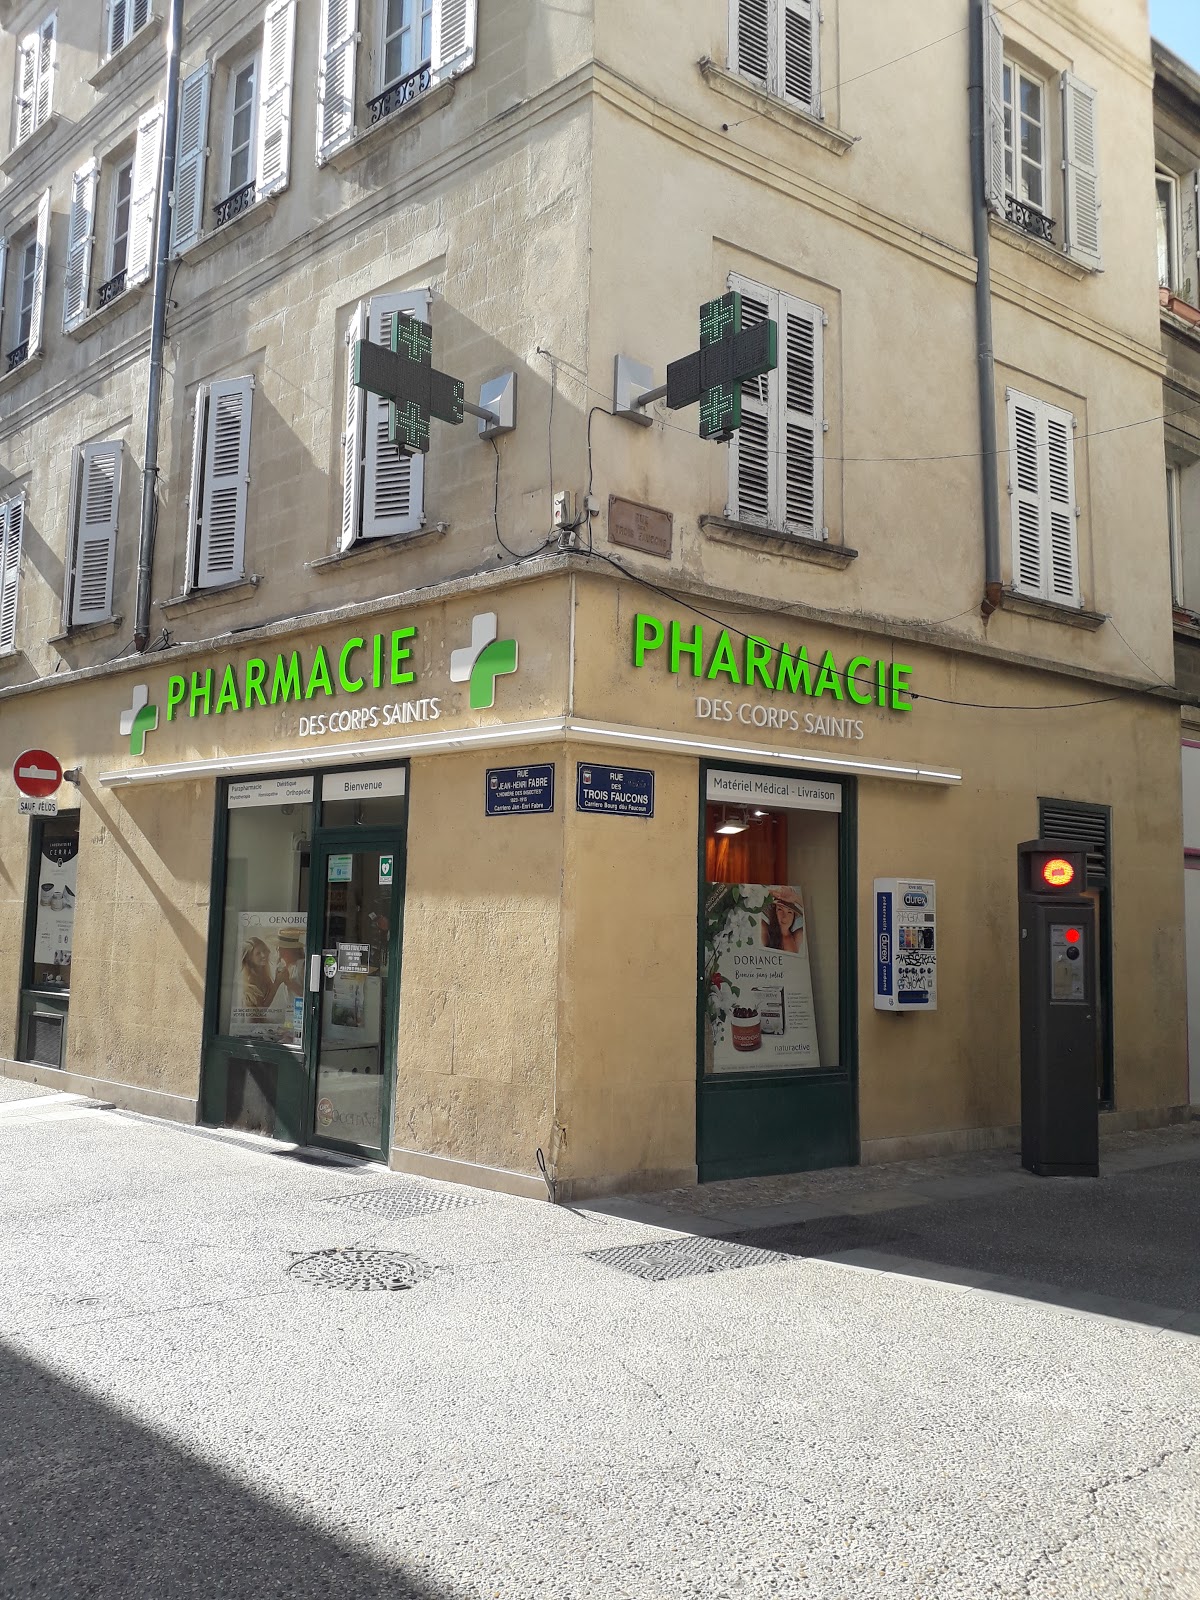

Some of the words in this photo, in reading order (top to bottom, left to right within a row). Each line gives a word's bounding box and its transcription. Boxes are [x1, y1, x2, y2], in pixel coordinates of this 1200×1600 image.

[633, 612, 914, 712] PHARMACIE
[167, 626, 418, 721] PHARMACIE
[299, 714, 327, 737] DES
[328, 705, 380, 732] CORPS
[382, 697, 442, 726] SAINTS
[695, 695, 733, 722] DES
[737, 702, 800, 732] CORPS
[804, 712, 865, 741] SAINTS
[516, 769, 529, 778] RUE
[609, 772, 623, 781] RUE
[231, 783, 263, 792] Parapharmacie
[344, 780, 382, 792] Bienvenue
[498, 780, 527, 790] JEAN-HENRI
[528, 777, 548, 787] FABRE
[713, 777, 753, 793] Matériel
[754, 781, 790, 796] Médical
[797, 785, 836, 801] Livraison
[583, 789, 608, 801] TROIS
[611, 792, 648, 804] FAUCONS
[20, 802, 36, 811] SAUF
[38, 801, 56, 811] VÉLOS
[604, 802, 617, 810] Bourg
[628, 804, 647, 812] Faucoun
[905, 894, 926, 904] durex
[734, 956, 783, 966] DORIANCE
[774, 1043, 810, 1051] naturactive
